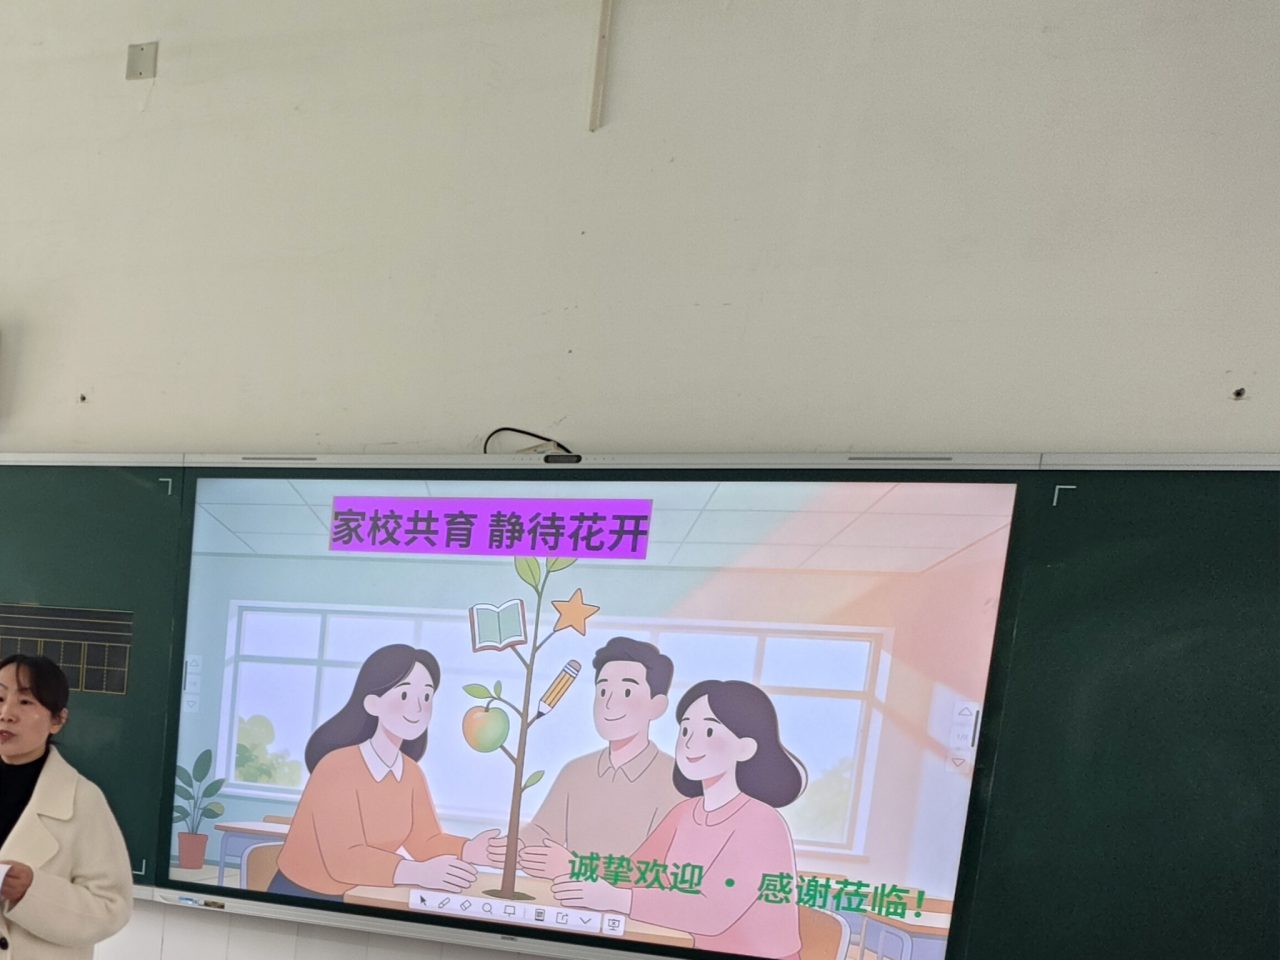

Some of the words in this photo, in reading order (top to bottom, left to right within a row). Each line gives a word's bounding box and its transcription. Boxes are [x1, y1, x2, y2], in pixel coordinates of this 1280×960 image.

[332, 509, 478, 549] 家校共育
[488, 511, 649, 553] 静待花开
[568, 850, 704, 895] 诚挚欢迎
